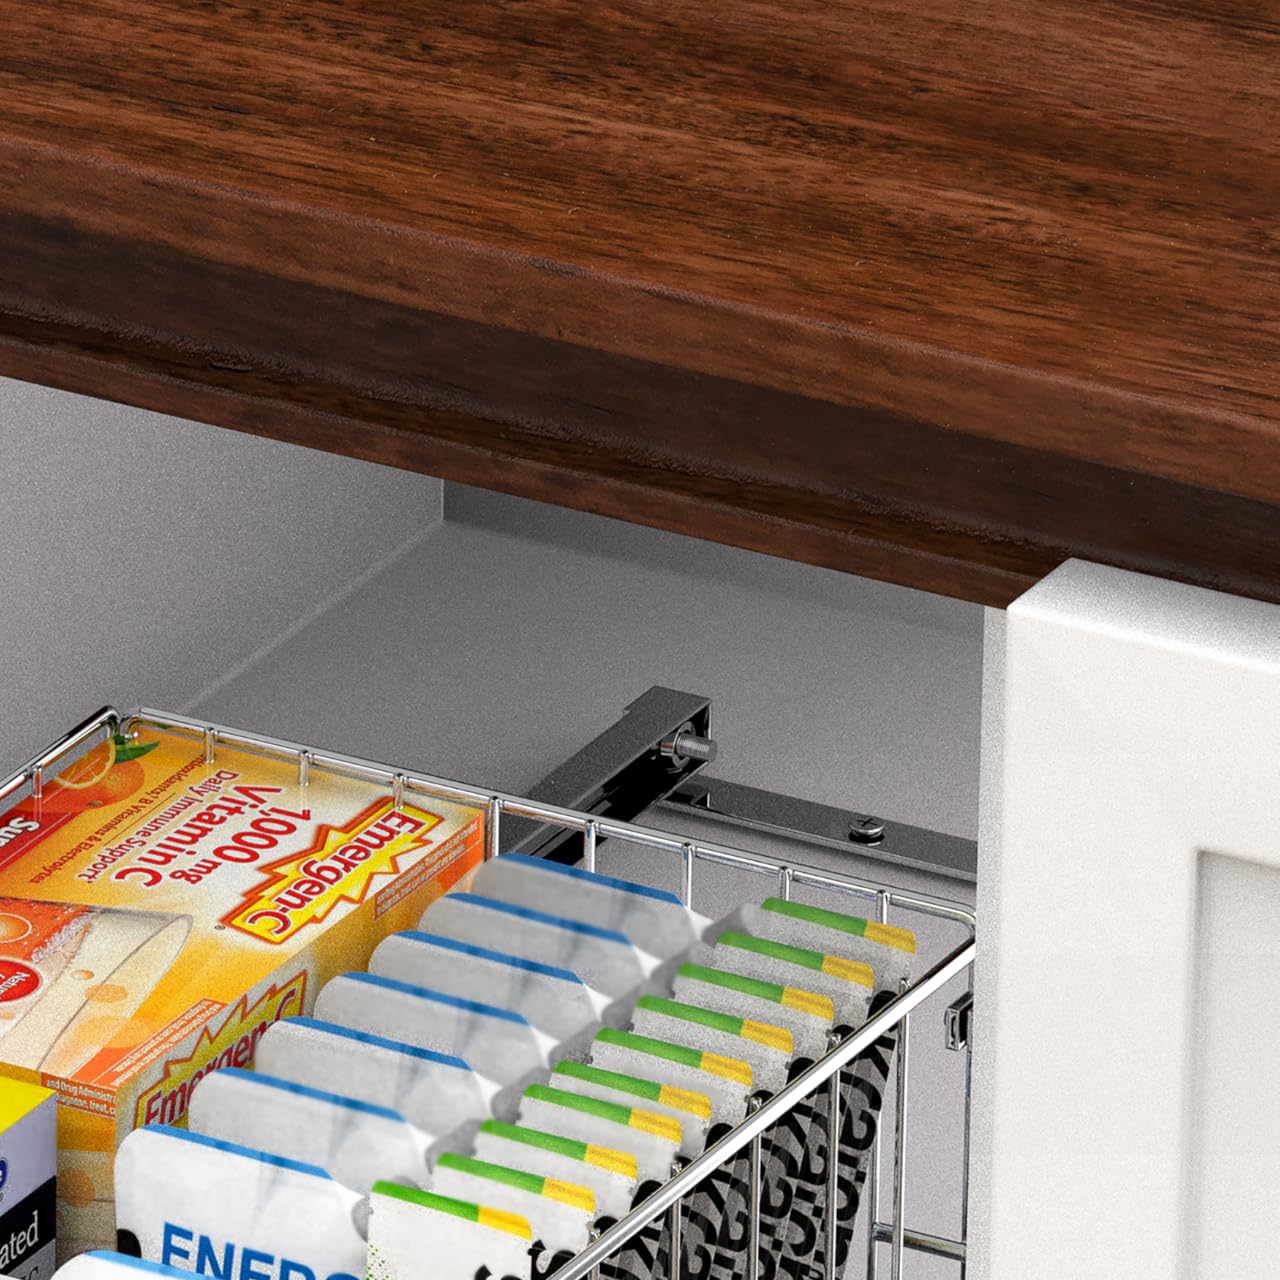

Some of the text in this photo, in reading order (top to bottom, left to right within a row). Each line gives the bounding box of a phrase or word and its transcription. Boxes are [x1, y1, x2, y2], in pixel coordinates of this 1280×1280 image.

[141, 796, 203, 838] Immune
[188, 769, 240, 797] Daily
[115, 785, 282, 888] Vitamin C
[169, 808, 310, 885] 1,000 mg
[248, 810, 427, 935] Emergen-C
